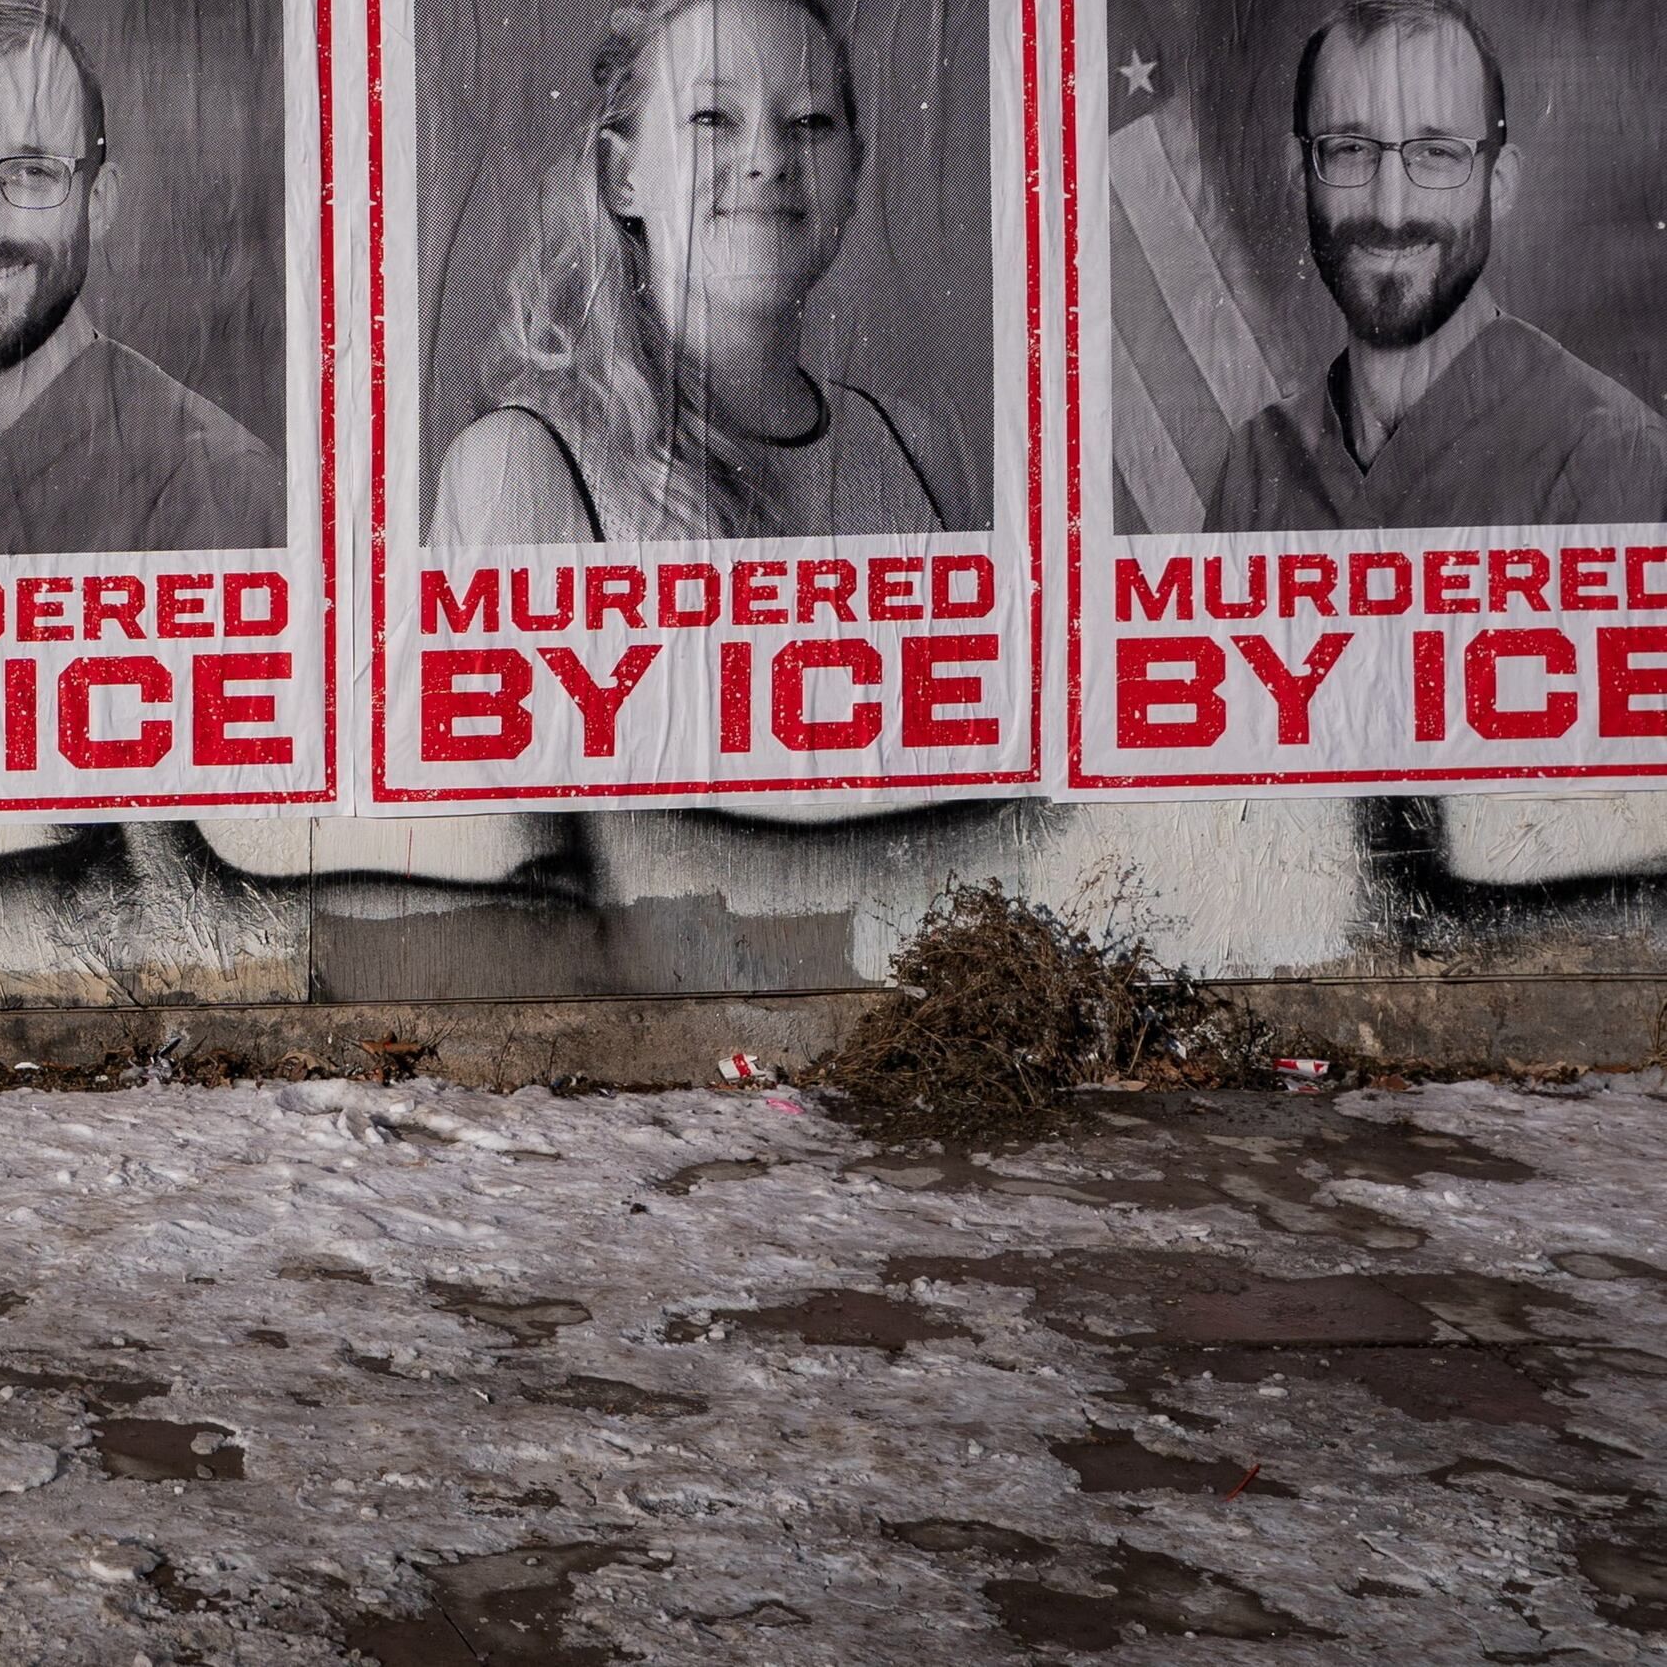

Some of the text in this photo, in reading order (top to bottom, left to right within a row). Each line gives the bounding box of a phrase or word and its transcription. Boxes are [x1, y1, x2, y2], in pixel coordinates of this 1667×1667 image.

[420, 554, 996, 635] MURDERED
[4, 651, 294, 772] ICE
[420, 633, 1000, 763] BY ICE
[1115, 632, 1355, 750] BY
